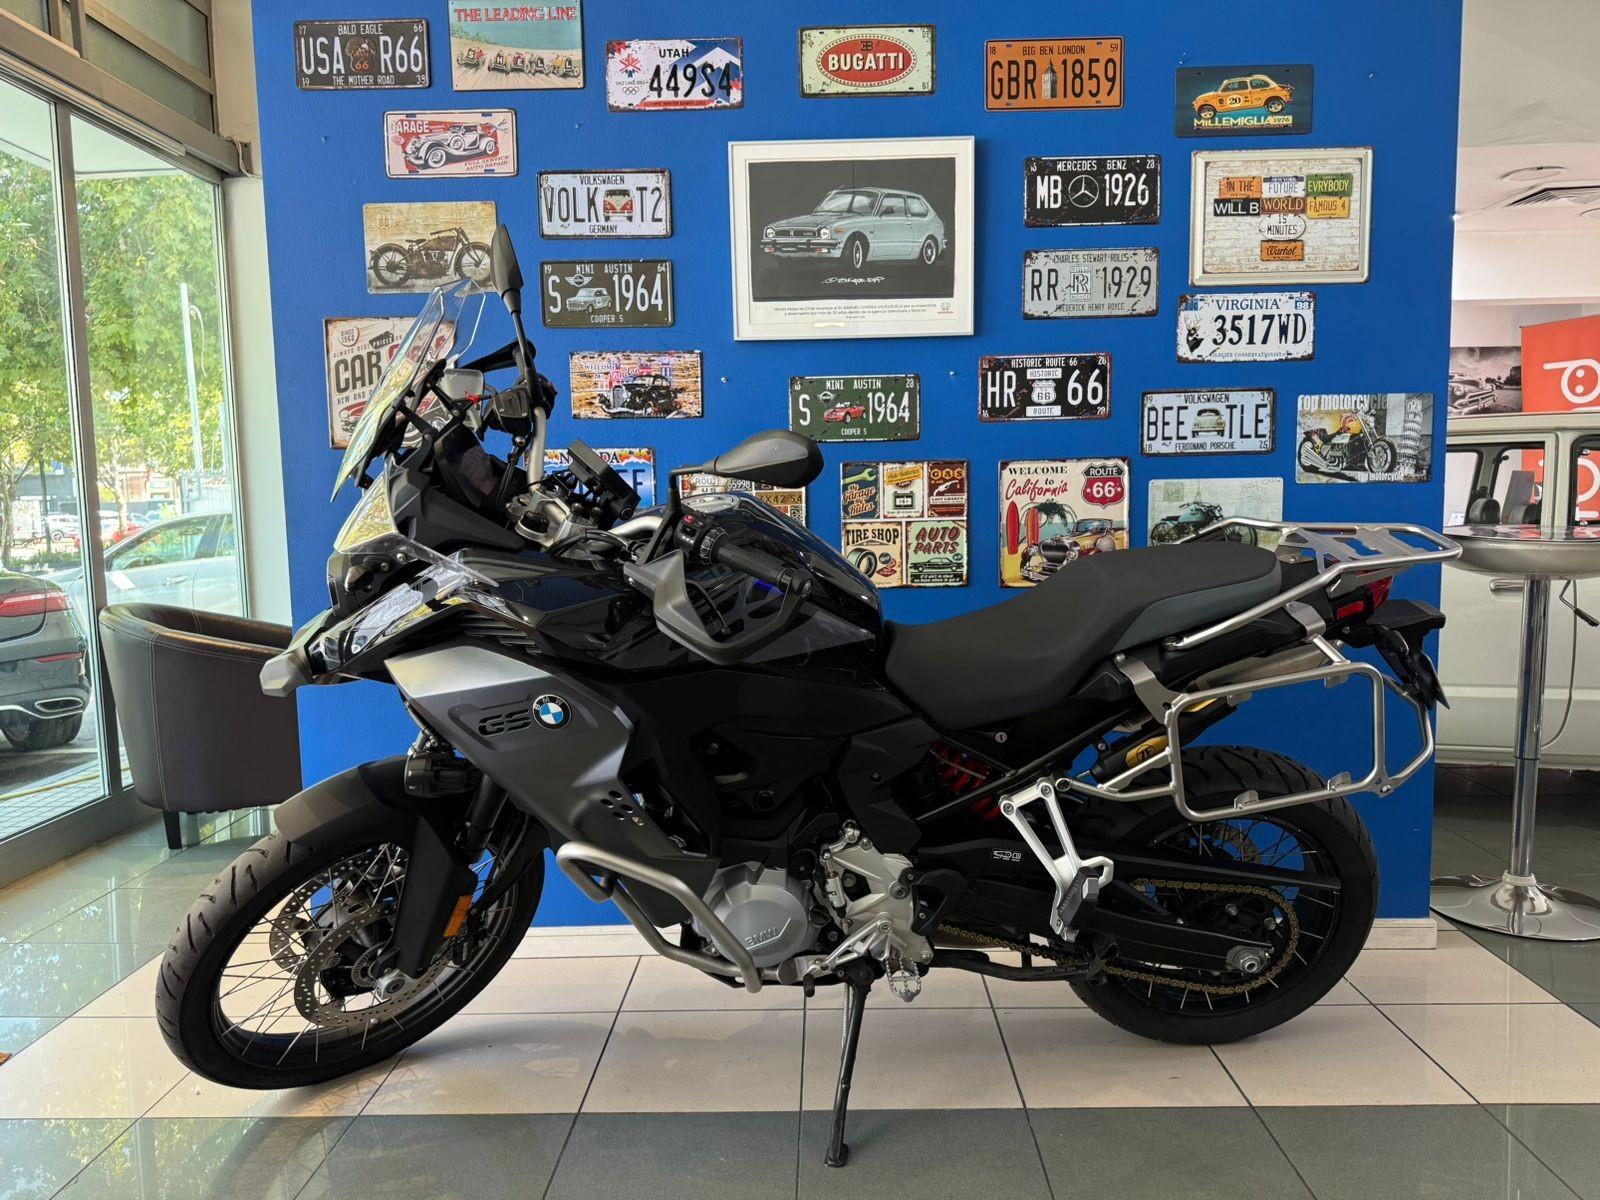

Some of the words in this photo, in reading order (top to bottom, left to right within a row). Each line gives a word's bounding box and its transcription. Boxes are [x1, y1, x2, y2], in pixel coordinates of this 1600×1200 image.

[454, 8, 481, 22] THE
[485, 7, 544, 21] LEADING
[546, 7, 577, 20] LINE
[338, 24, 358, 35] BALD
[360, 23, 386, 35] EAGLE
[413, 23, 424, 33] 66
[658, 48, 689, 58] UTAH
[1022, 46, 1036, 56] BIG
[1039, 45, 1054, 55] BEN
[1057, 44, 1086, 55] LONDON
[1110, 43, 1119, 53] 59
[301, 36, 346, 76] USA
[379, 34, 423, 74] R66
[828, 52, 906, 72] BUGATTI
[333, 76, 347, 86] THE
[349, 75, 375, 86] MOTHER
[377, 74, 396, 85] ROAD
[991, 60, 1037, 100] GBR
[1061, 57, 1117, 99] 1859
[1056, 161, 1098, 172] MERCEDES
[1106, 159, 1128, 170] BENZ
[579, 174, 625, 186] VOLKSWAGEN
[1226, 181, 1236, 192] IN
[1239, 180, 1255, 192] THE
[1308, 178, 1349, 192] EVRYBODY
[1036, 174, 1062, 209] MB
[1104, 173, 1151, 207] 1926
[1268, 182, 1298, 194] FUTURE
[543, 186, 600, 223] VOLK
[635, 186, 664, 223] T2
[1214, 202, 1247, 215] WILL
[1250, 201, 1260, 215] B
[1263, 198, 1304, 212] WORLD
[1309, 201, 1337, 213] FAMOUS
[589, 225, 618, 235] GERMANY
[1266, 225, 1298, 236] MINUTES
[1052, 253, 1079, 264] CHARLES
[1082, 253, 1107, 264] STEWART
[576, 264, 595, 275] MINI
[603, 263, 633, 275] AUSTIN
[1031, 268, 1059, 301] RR
[1101, 265, 1153, 300] 1929
[548, 275, 562, 314] S
[612, 272, 664, 313] 1964
[1216, 299, 1280, 311] VIRGINIA
[1296, 301, 1309, 310] 98
[590, 314, 616, 324] COOPER
[1212, 312, 1307, 347] 3517WD
[1011, 358, 1042, 368] HISTORIC
[1045, 357, 1067, 367] ROUTE
[1069, 356, 1079, 367] 66
[334, 350, 382, 394] CAR
[1030, 369, 1059, 378] HISTORIC
[825, 379, 844, 391] MINI
[853, 378, 882, 391] AUSTIN
[987, 369, 1017, 408] HR
[1067, 368, 1104, 406] 66
[1037, 392, 1053, 401] 66
[1183, 393, 1231, 404] VOLKSWAGEN
[798, 393, 811, 426] S
[867, 391, 911, 424] 1964
[1033, 406, 1054, 416] ROUTE
[1146, 405, 1189, 441] BEE
[1225, 403, 1268, 440] TLE
[841, 428, 861, 436] COOPER
[1174, 441, 1208, 452] FERDINAND
[1209, 440, 1236, 451] PORSCHE
[1008, 466, 1068, 475] WELCOME
[1089, 467, 1120, 477] ROUTE
[1044, 478, 1055, 486] to
[1005, 478, 1069, 502] California
[1091, 480, 1117, 499] 66
[845, 529, 870, 547] TIRE
[871, 528, 900, 546] SHOP
[915, 526, 961, 543] AUTO
[913, 540, 959, 556] PARTS
[478, 709, 532, 737] GS
